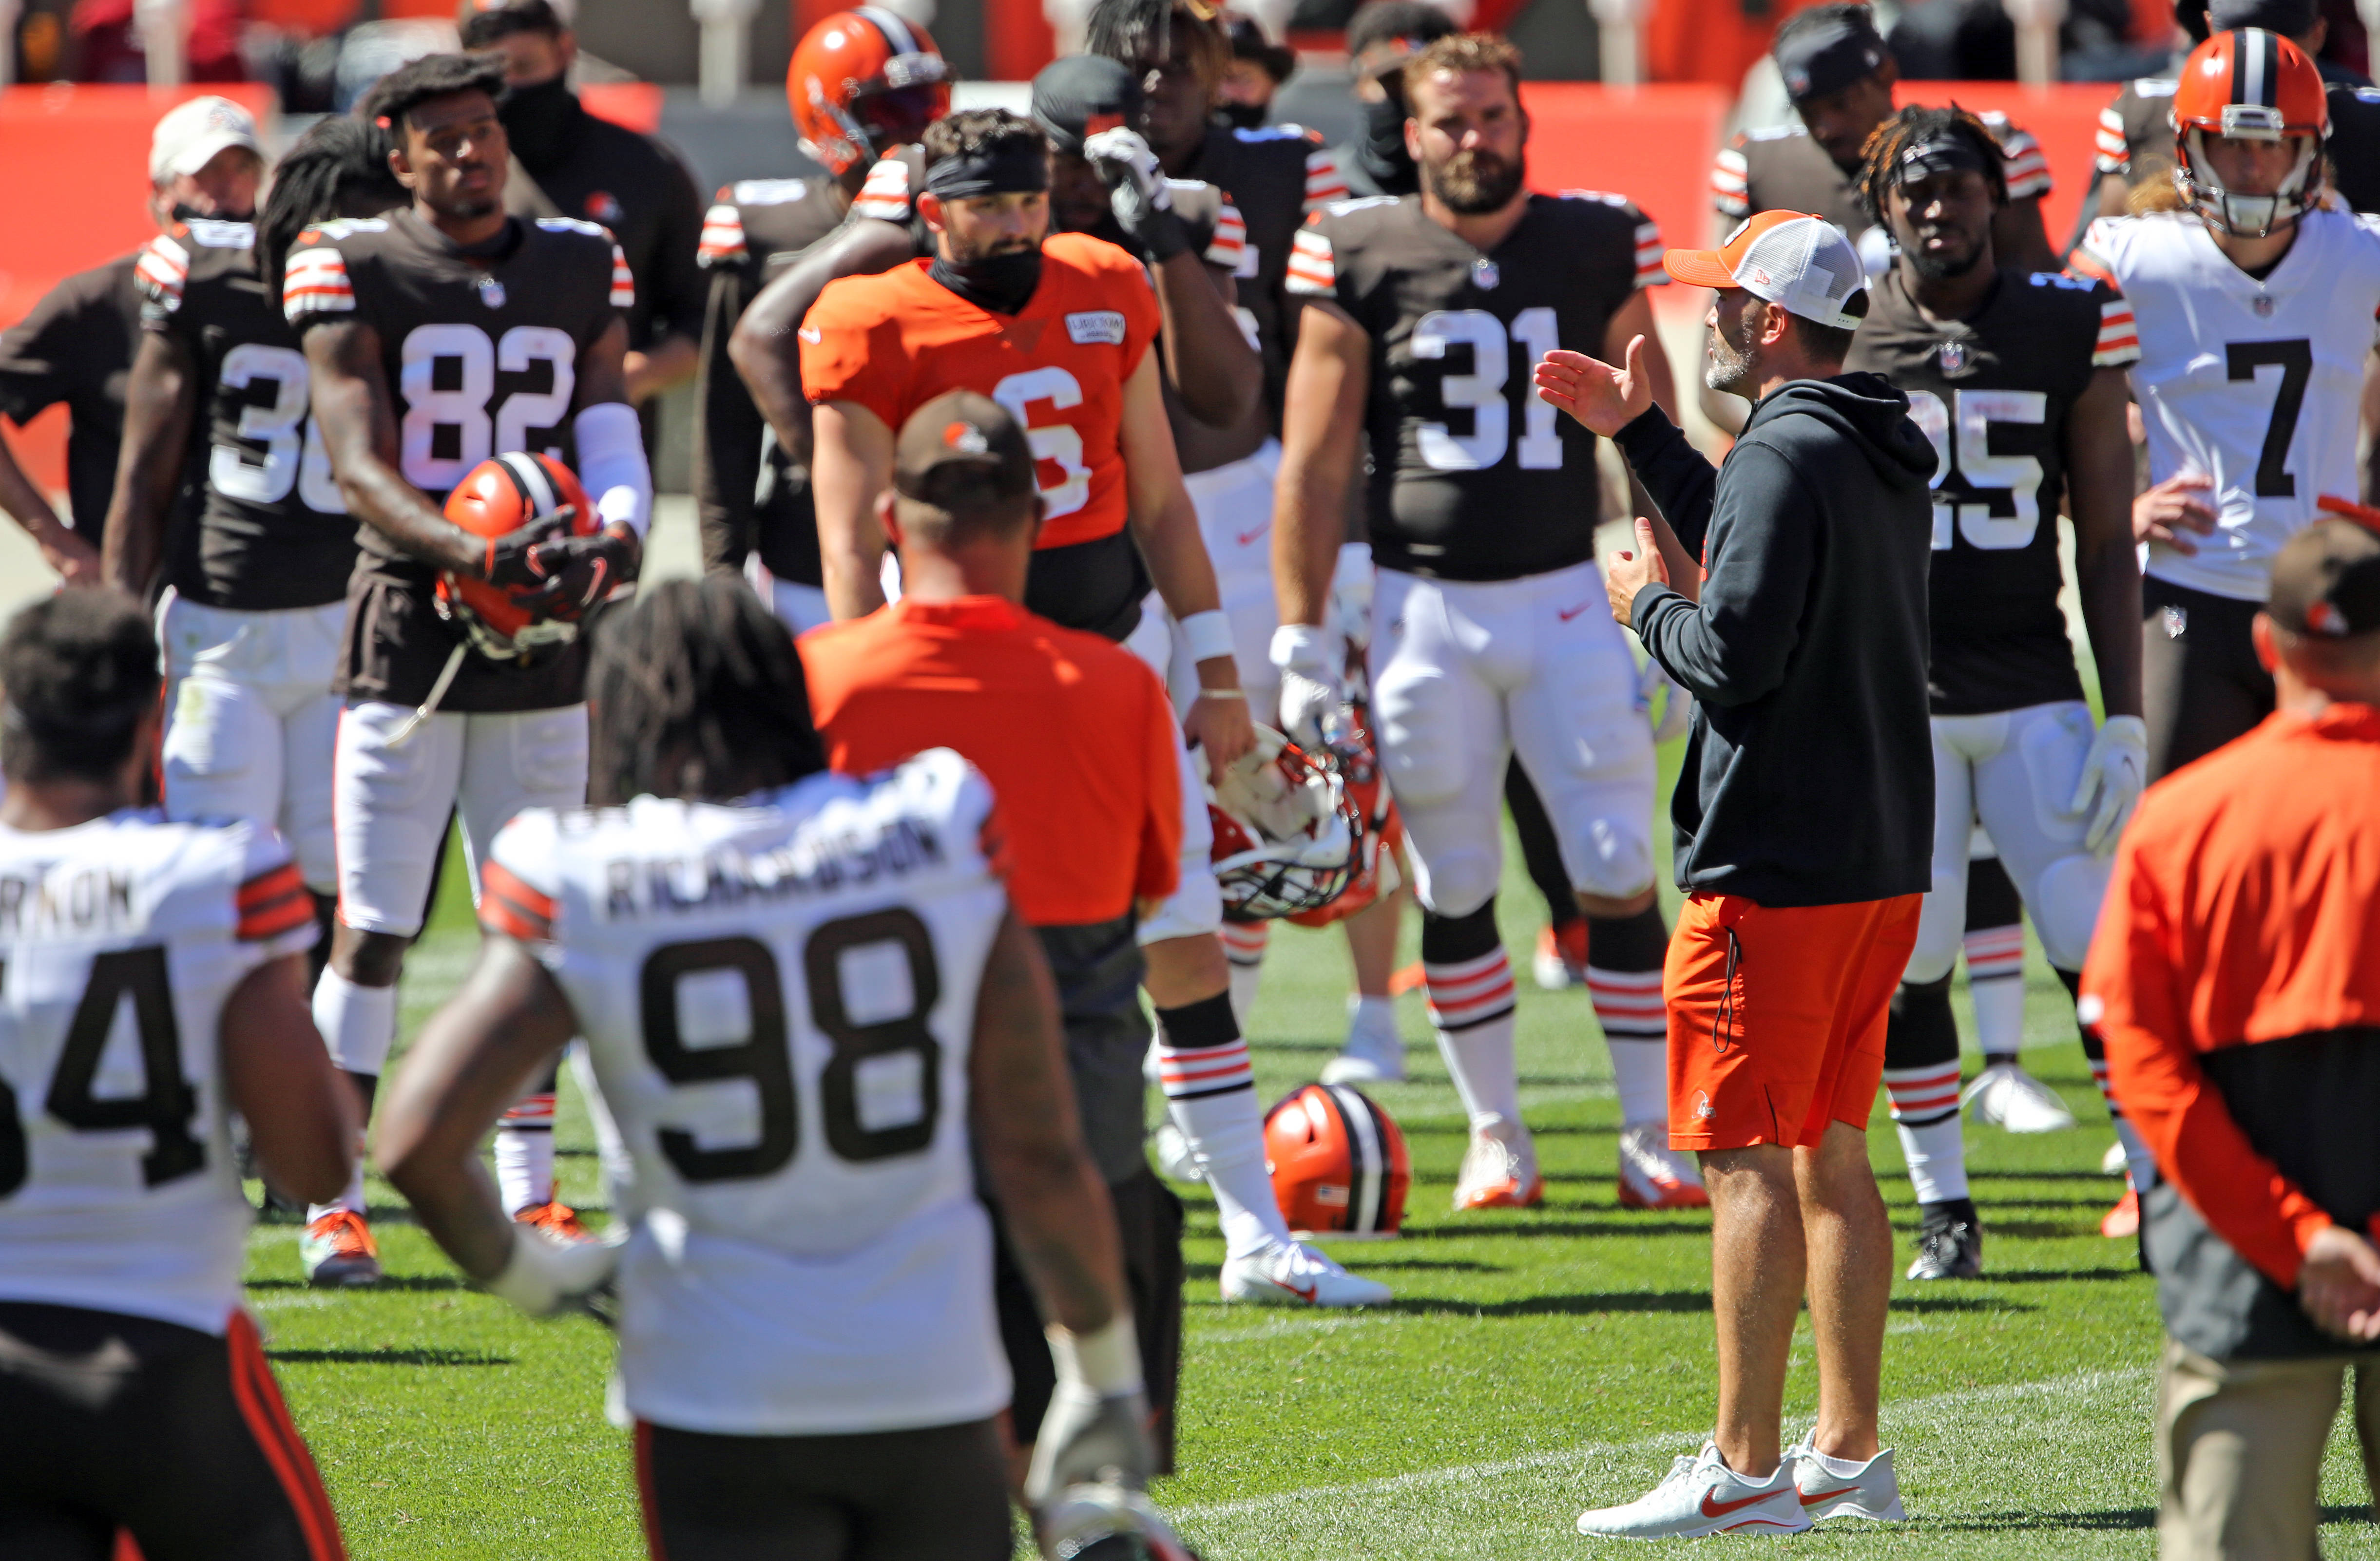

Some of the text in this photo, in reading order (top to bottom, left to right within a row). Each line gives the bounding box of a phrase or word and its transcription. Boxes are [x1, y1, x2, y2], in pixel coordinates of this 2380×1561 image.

[402, 324, 576, 489] 82
[993, 366, 1092, 519] 6
[1411, 308, 1562, 469] 31
[2226, 340, 2313, 496] 7
[0, 945, 207, 1199] 4
[642, 908, 940, 1181] 98
